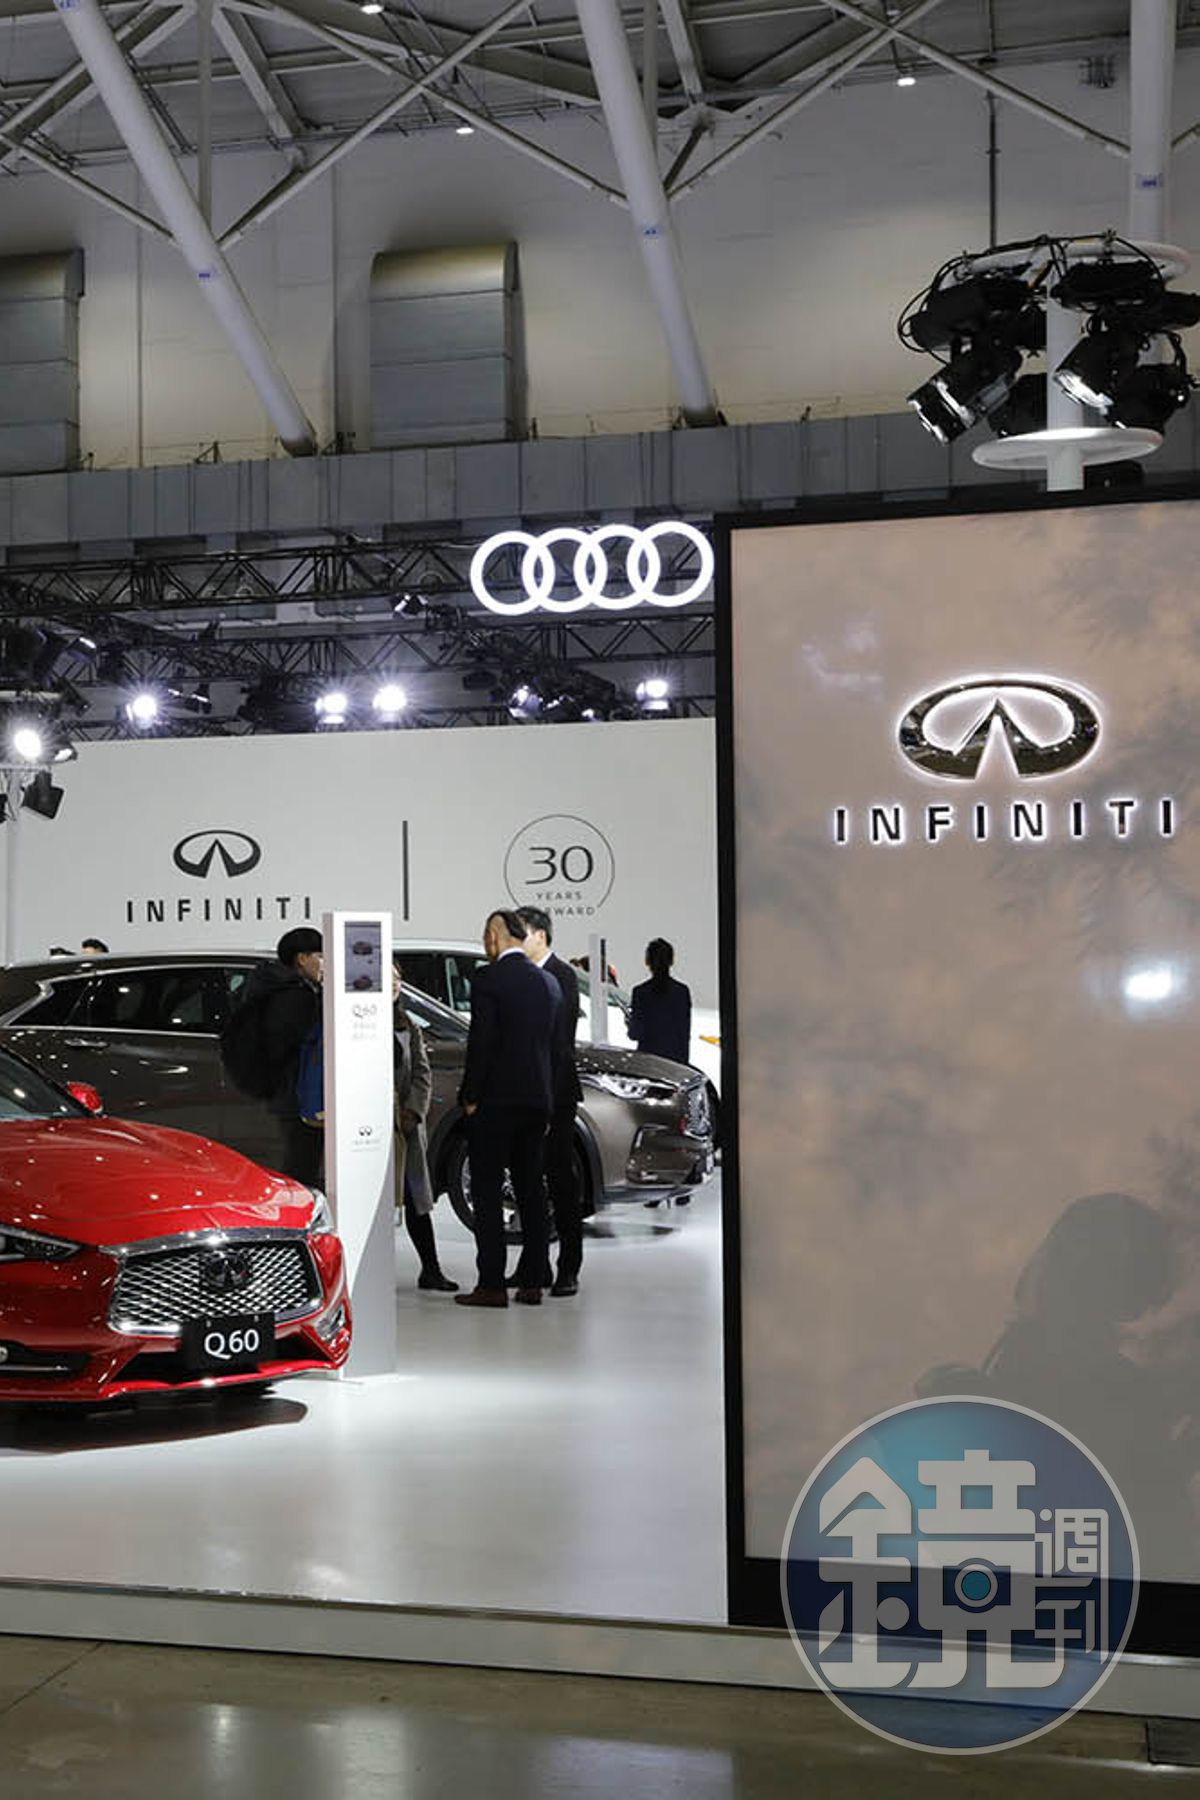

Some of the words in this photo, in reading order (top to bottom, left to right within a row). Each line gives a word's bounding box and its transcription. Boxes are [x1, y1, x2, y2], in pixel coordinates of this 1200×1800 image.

[835, 799, 1174, 843] INFINITI
[525, 845, 594, 885] 30
[127, 896, 311, 923] INFINITI
[536, 891, 582, 901] YEARS
[204, 1328, 260, 1360] Q60
